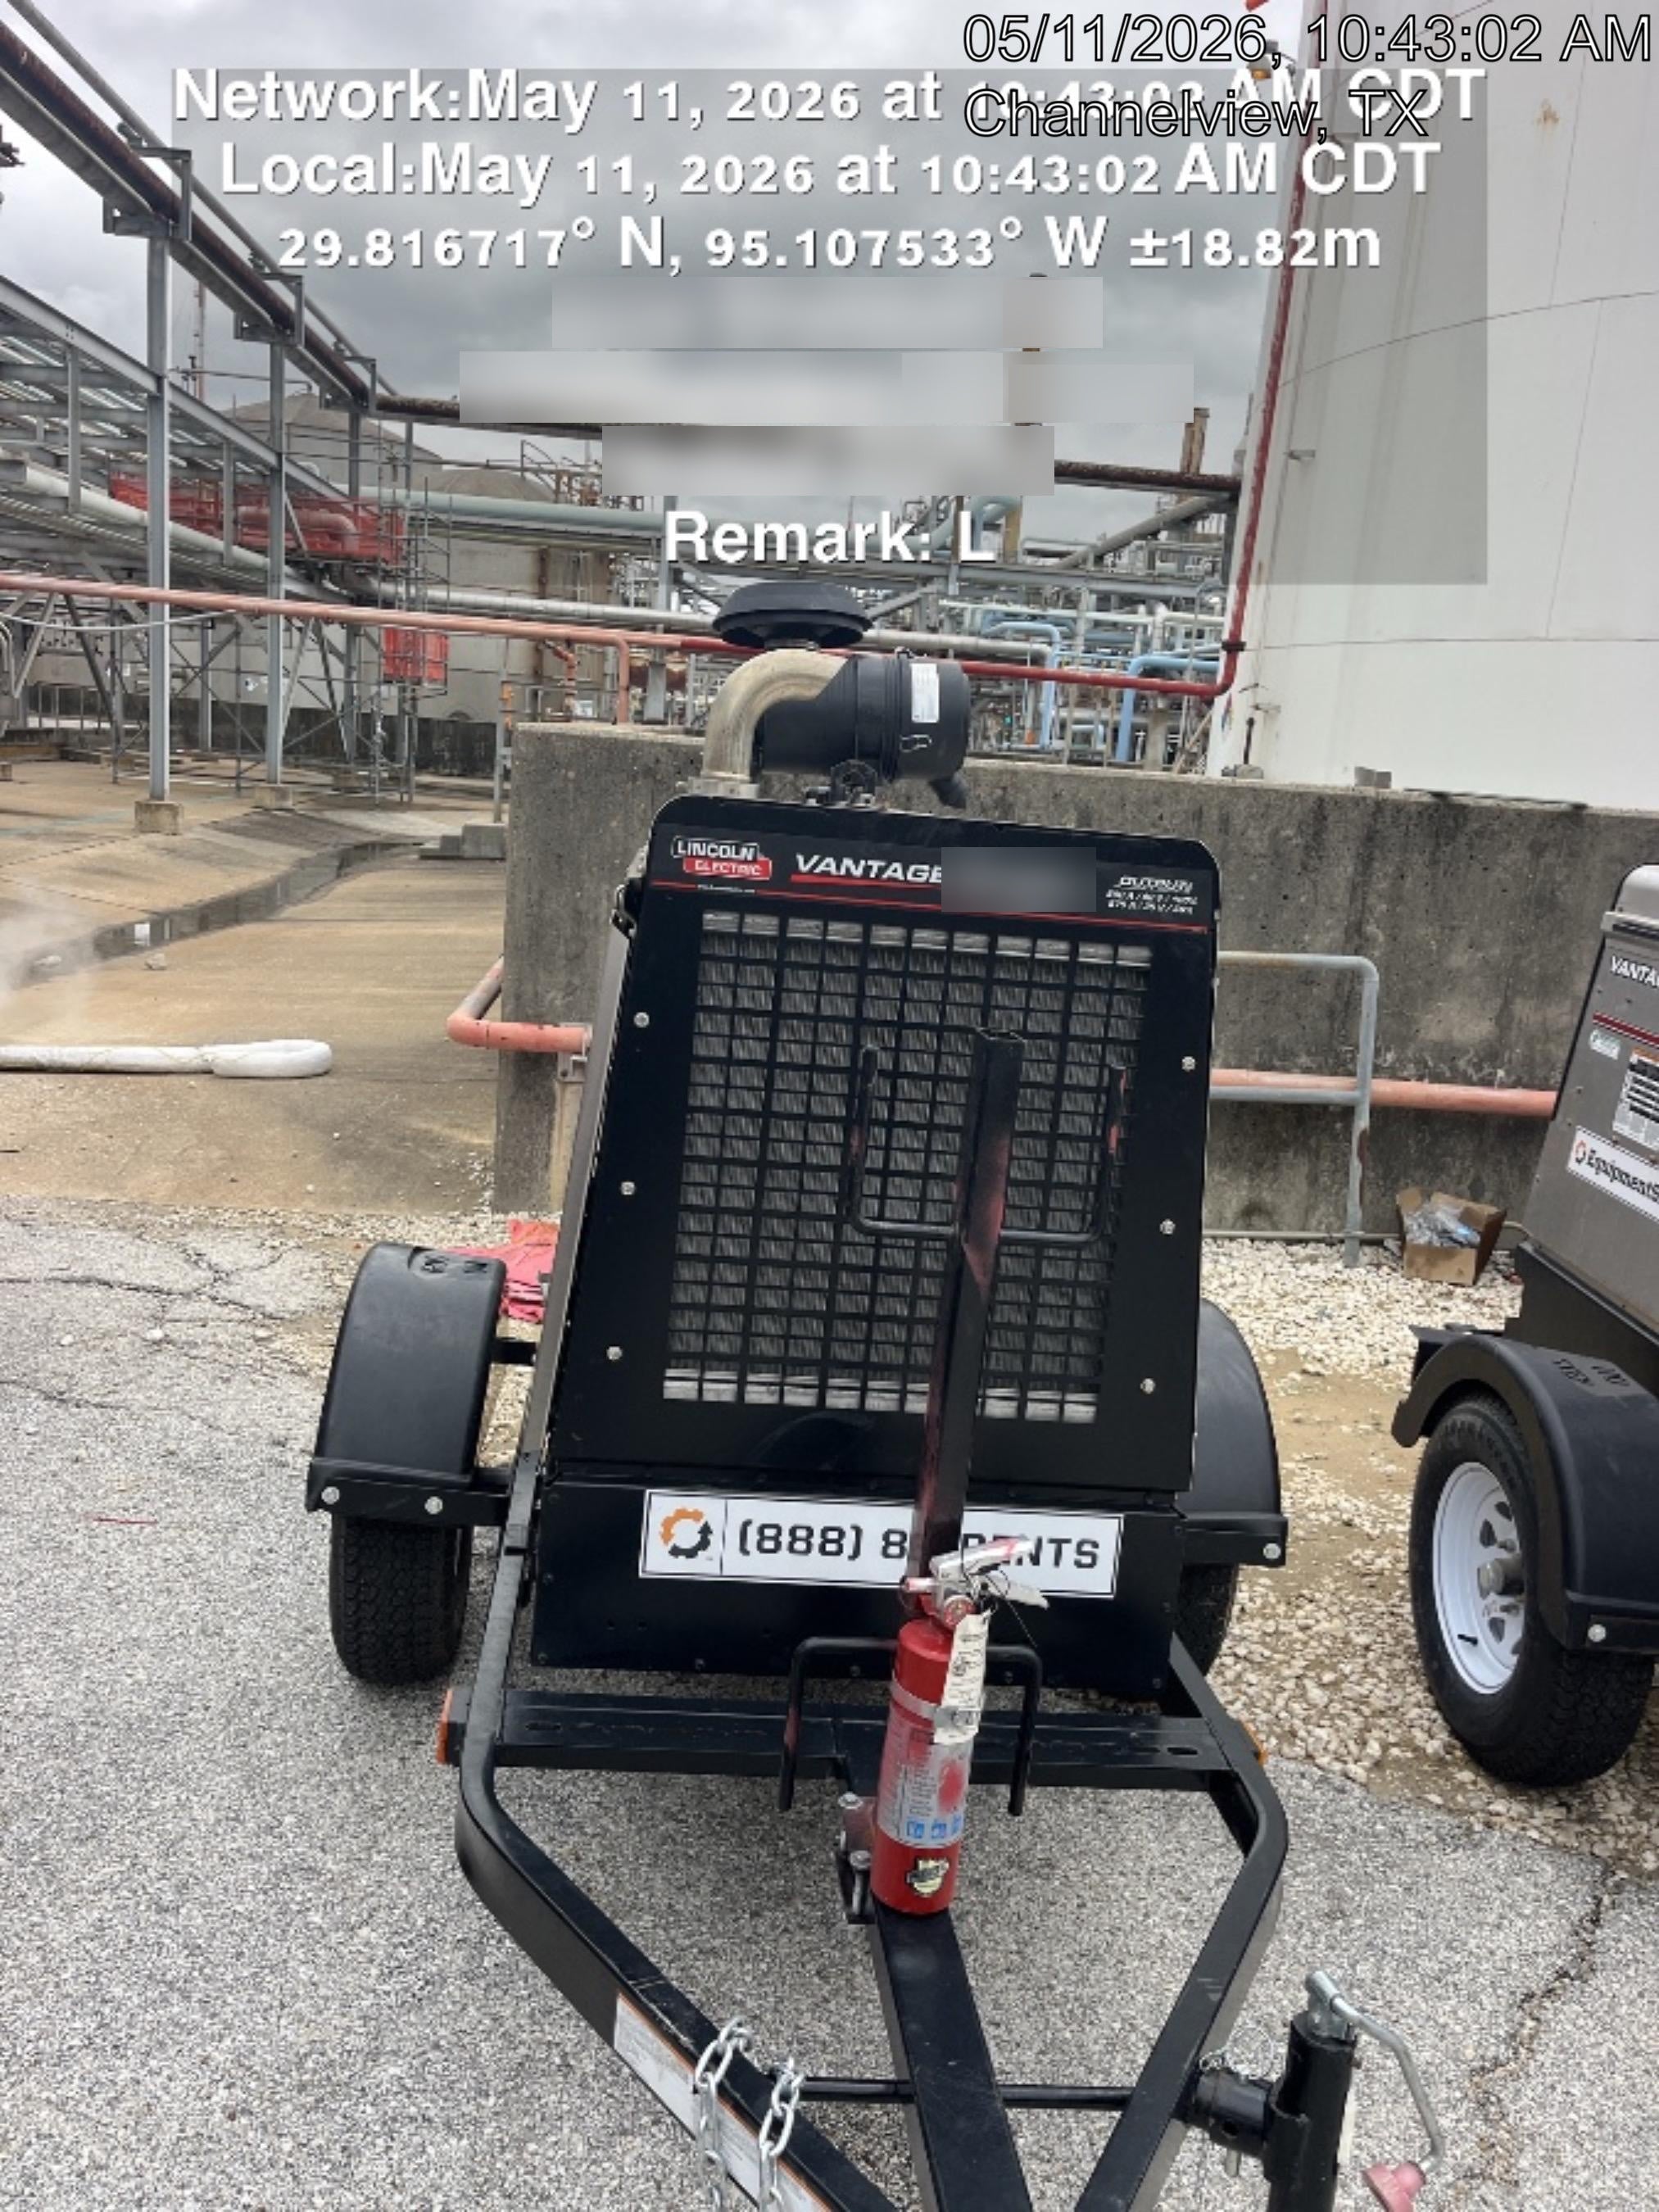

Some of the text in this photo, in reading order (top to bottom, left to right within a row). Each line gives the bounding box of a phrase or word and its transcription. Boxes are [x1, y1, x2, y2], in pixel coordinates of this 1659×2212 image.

[677, 840, 755, 861] LINCOLN
[695, 859, 763, 876] ELECTRIC
[1611, 954, 1659, 988] VANTA
[739, 1518, 863, 1561] (888)
